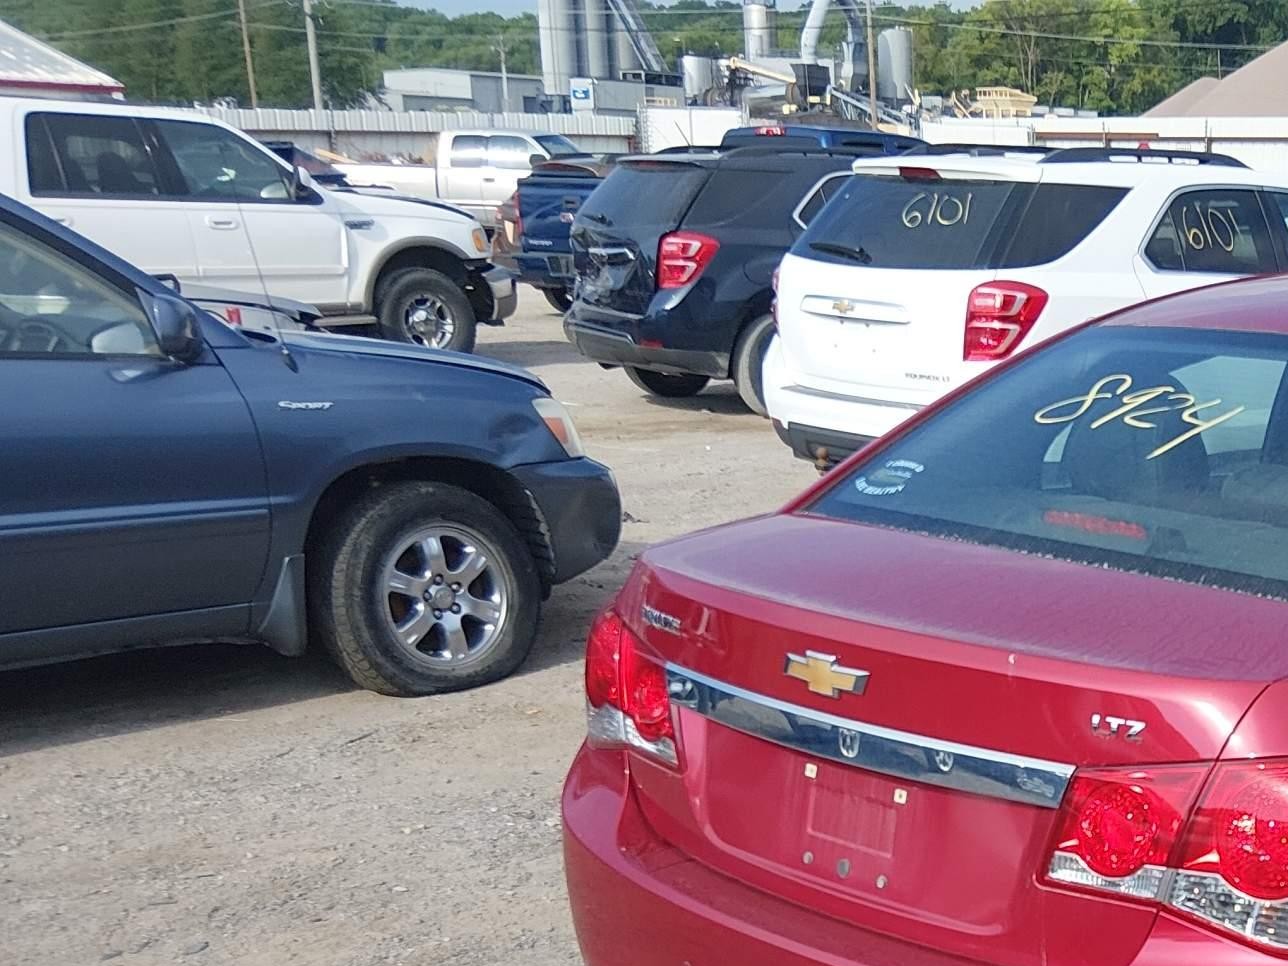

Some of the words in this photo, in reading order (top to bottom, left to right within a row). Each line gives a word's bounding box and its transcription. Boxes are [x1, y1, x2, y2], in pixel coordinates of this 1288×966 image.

[902, 192, 973, 228] 6101
[1182, 201, 1242, 252] 6101
[1034, 373, 1246, 460] 8924
[1091, 713, 1147, 742] LTZ
